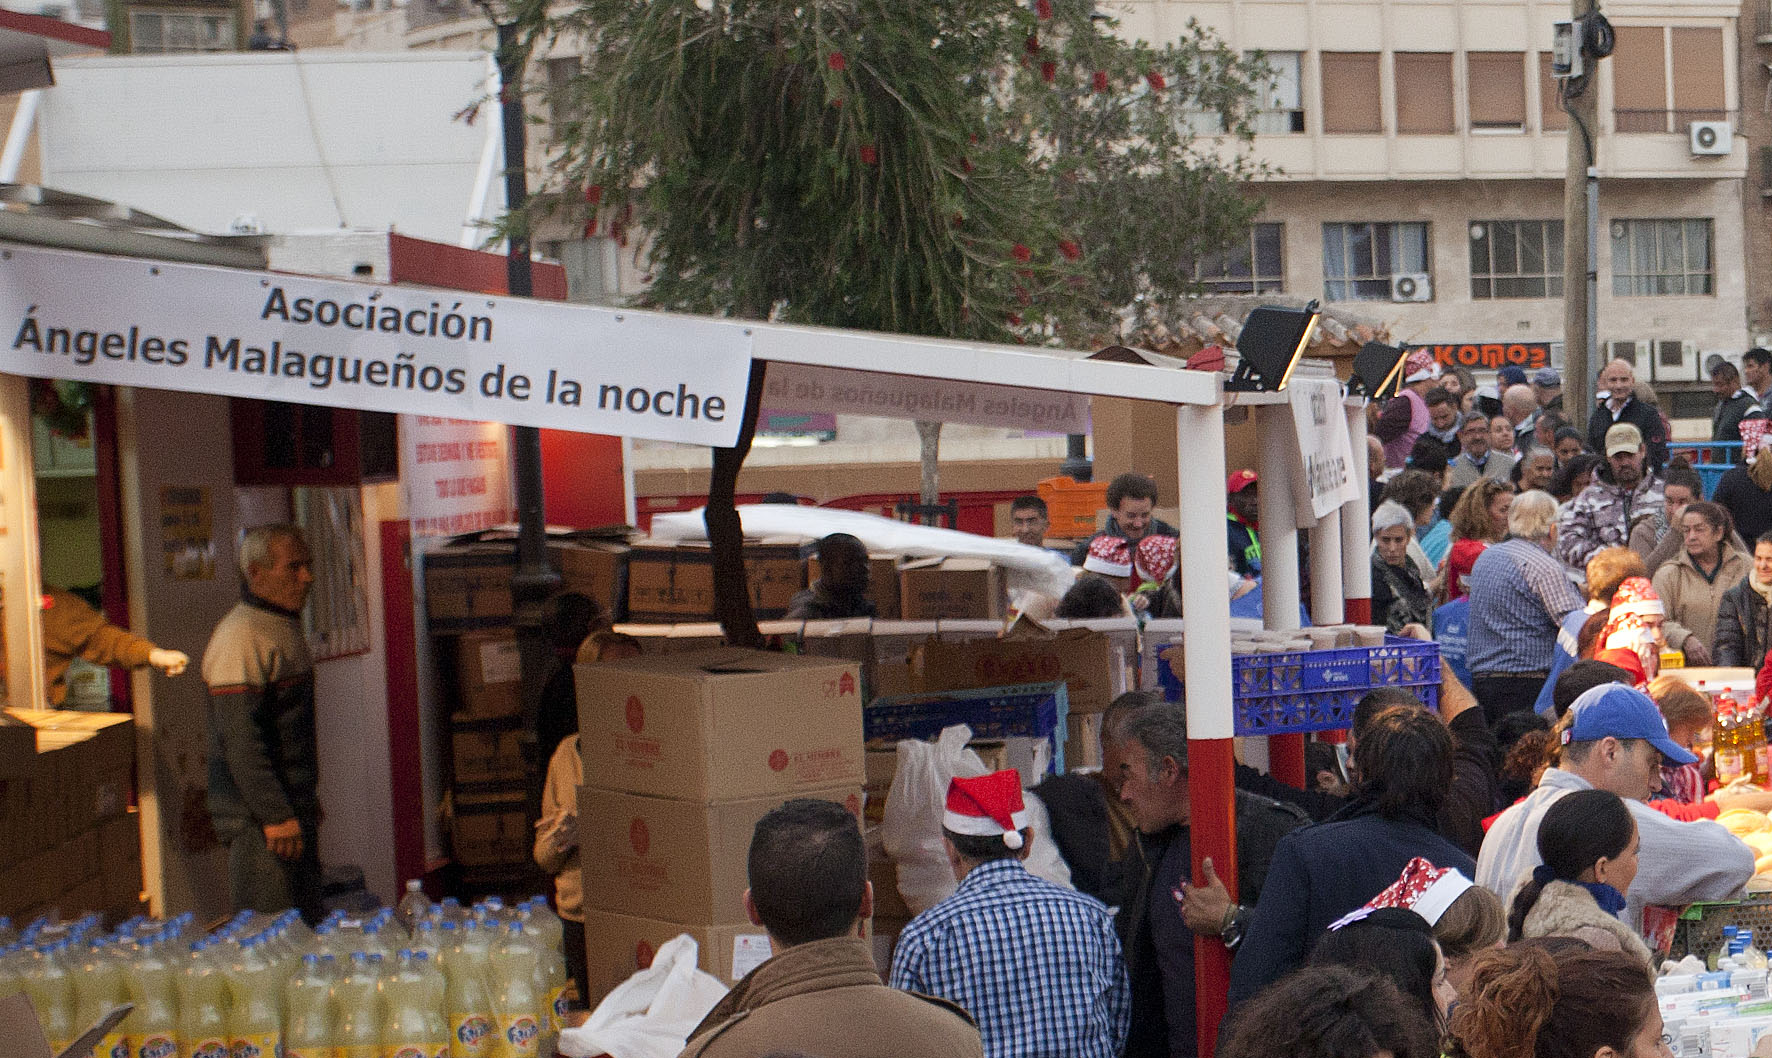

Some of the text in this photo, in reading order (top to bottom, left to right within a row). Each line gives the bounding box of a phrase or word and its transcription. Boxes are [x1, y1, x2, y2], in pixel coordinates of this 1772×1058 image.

[261, 288, 493, 342] Asociación
[12, 304, 726, 423] Ángeles Malagueños de la noche
